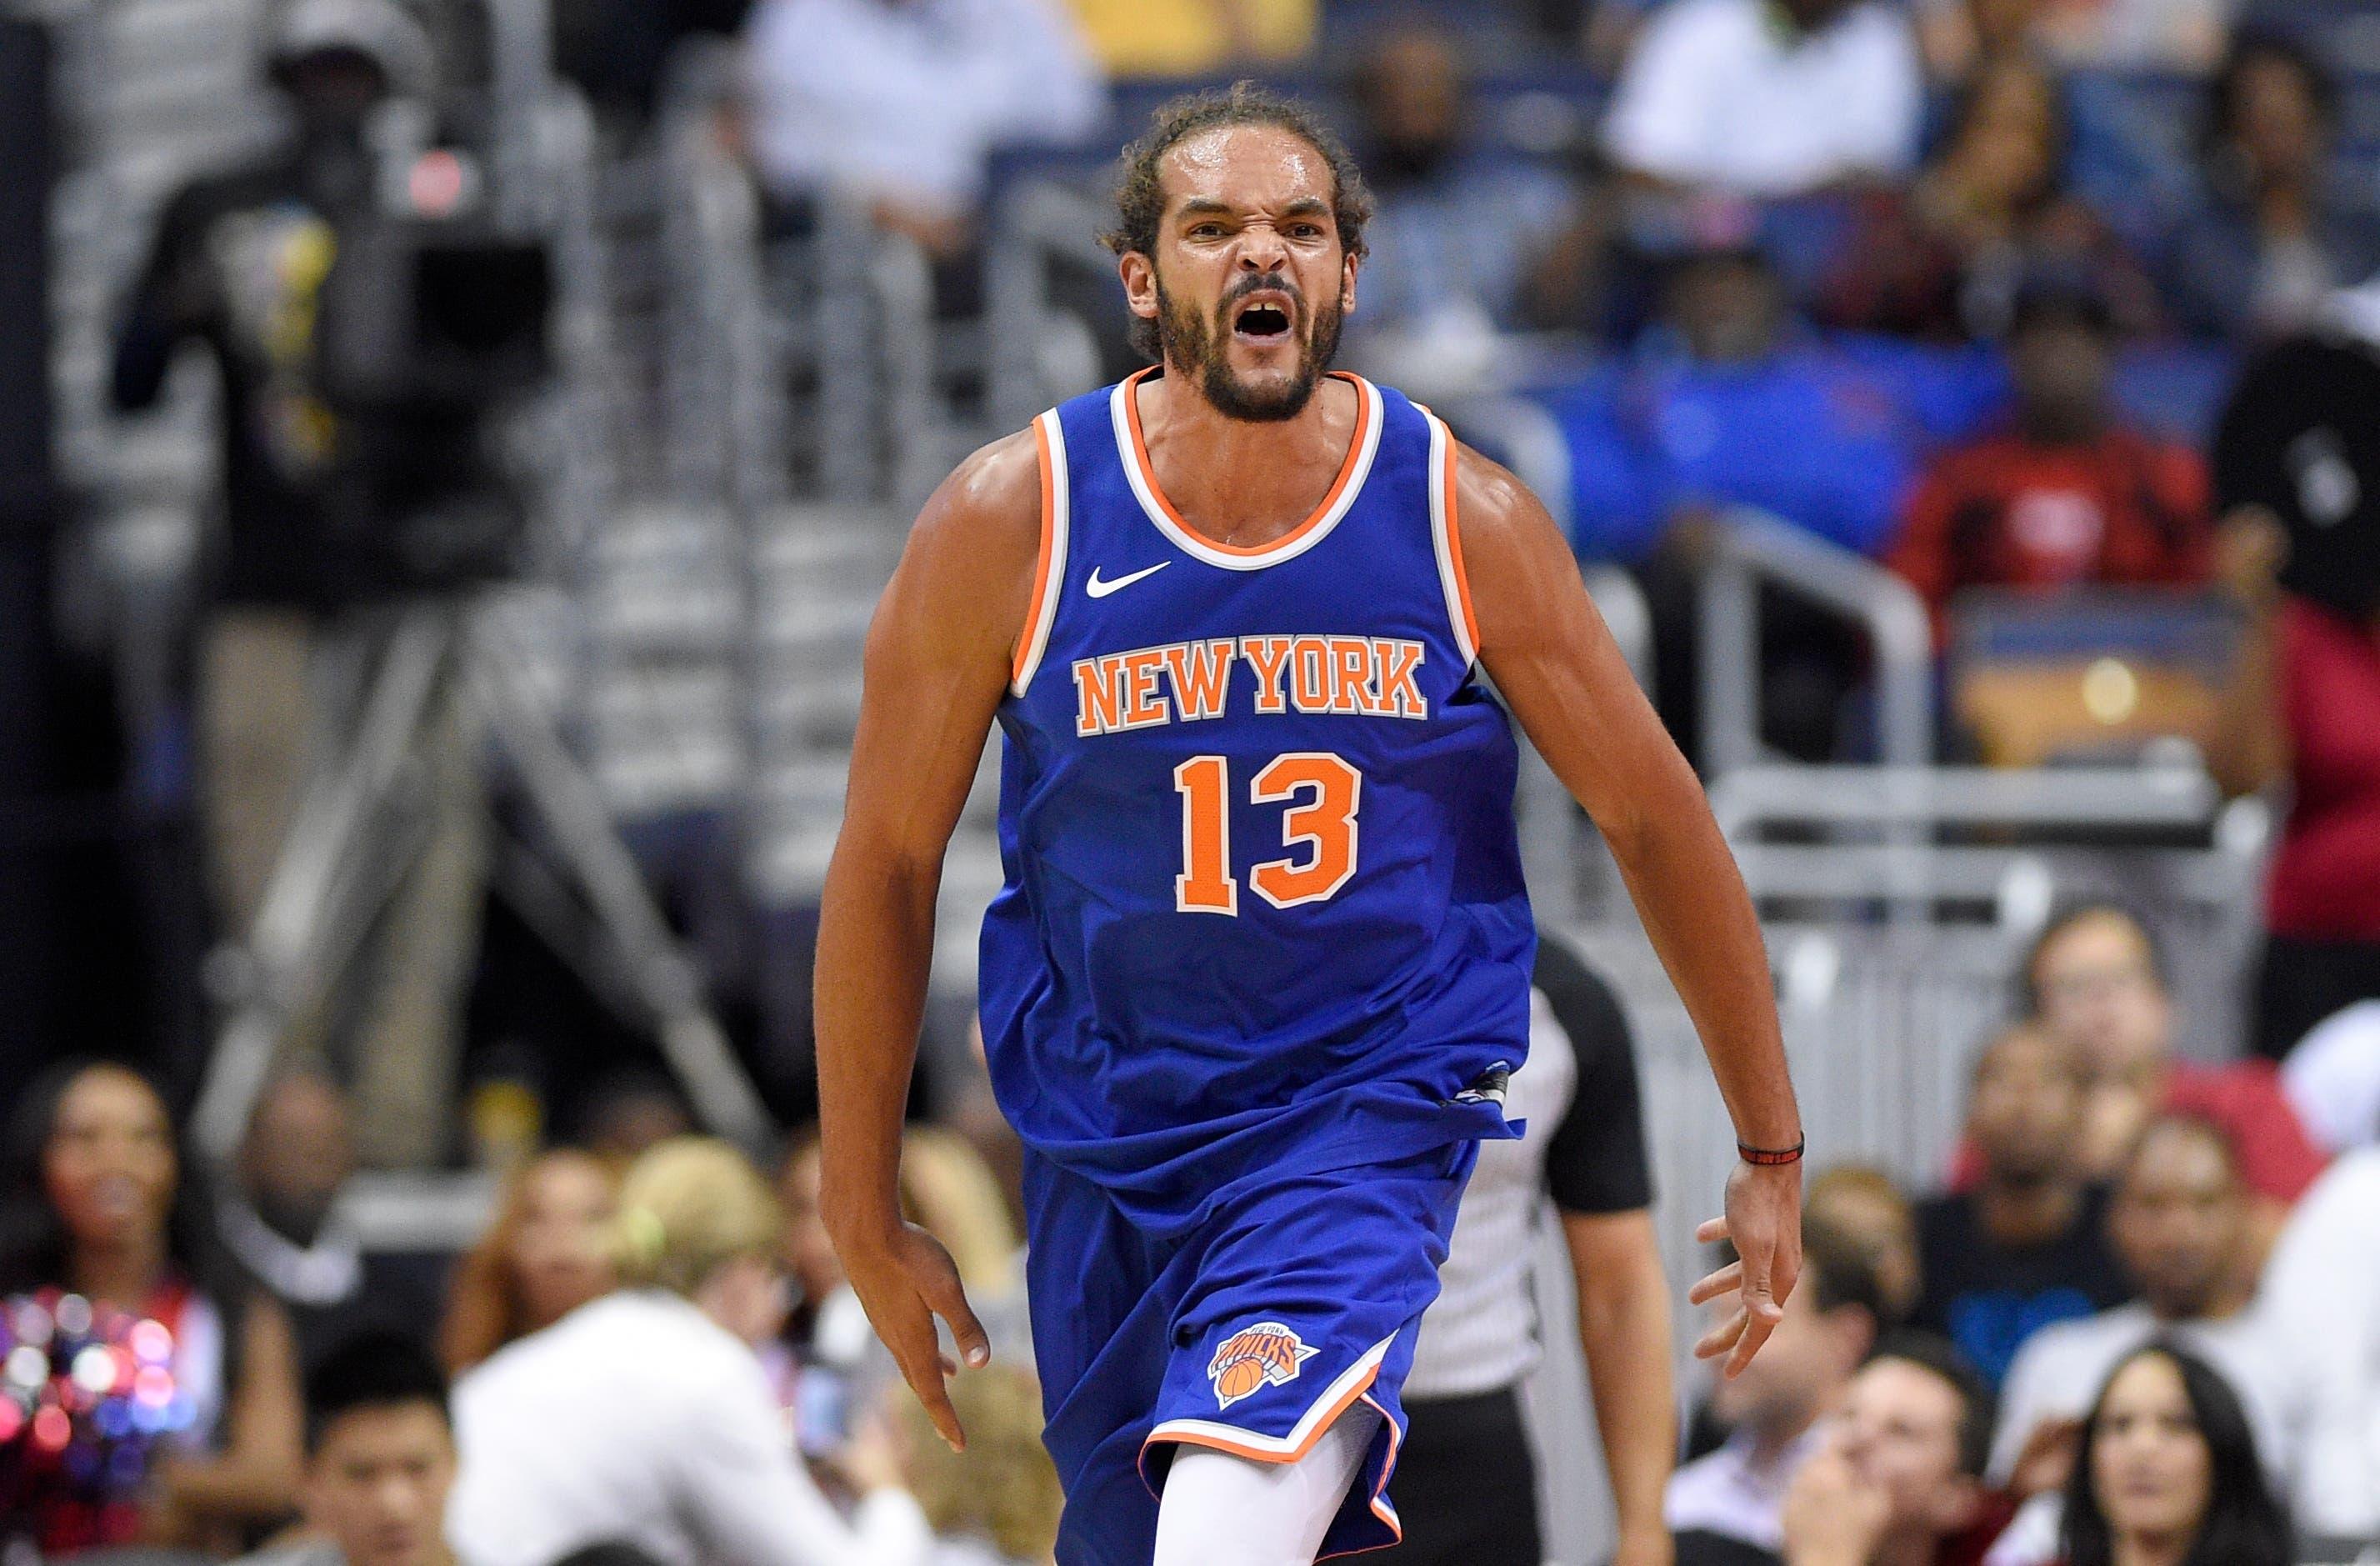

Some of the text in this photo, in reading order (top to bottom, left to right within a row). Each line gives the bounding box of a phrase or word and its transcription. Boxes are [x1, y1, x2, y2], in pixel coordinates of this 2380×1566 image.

[1072, 634, 1428, 737] NEW YORK
[1173, 752, 1362, 917] 13
[1212, 1333, 1296, 1374] KNICKS
